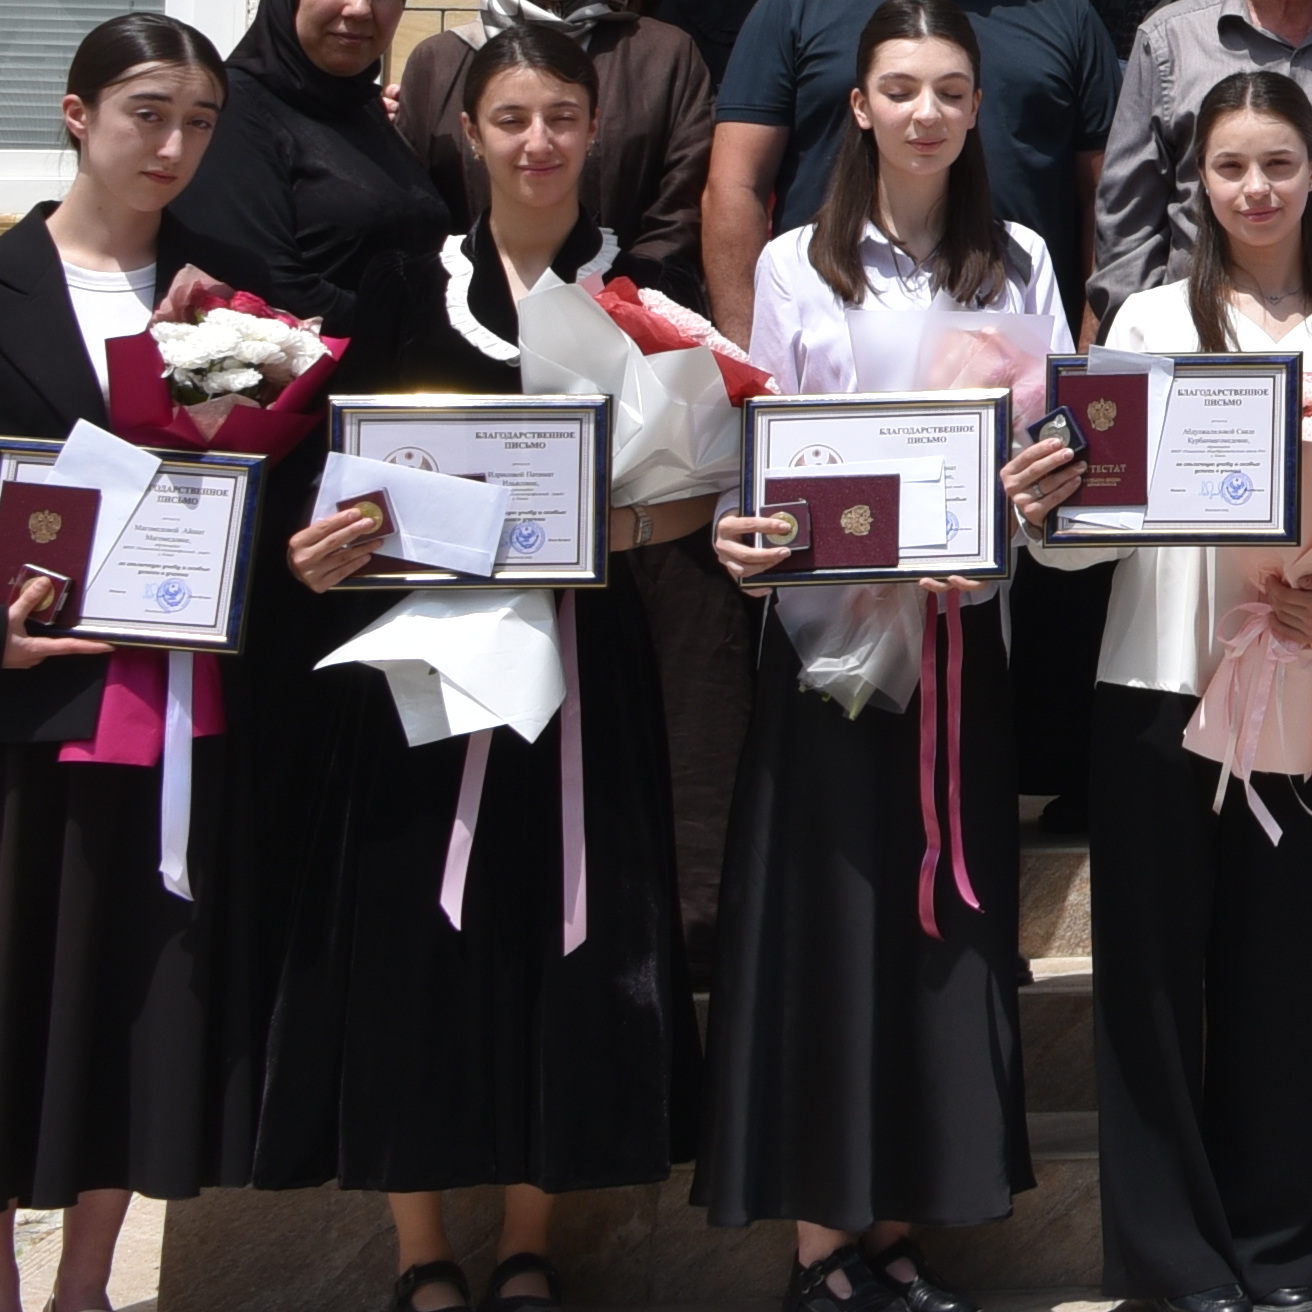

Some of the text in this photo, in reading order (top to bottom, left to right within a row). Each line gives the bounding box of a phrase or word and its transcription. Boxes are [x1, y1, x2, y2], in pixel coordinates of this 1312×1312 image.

[1177, 388, 1269, 397] БЛАГОДАРСТВЕННОЕ
[879, 425, 975, 435] БЛАГОДАРСТВЕННОЕ
[475, 431, 576, 439] БЛАГОДАРСТВЕННОЕ
[907, 436, 947, 444] ПИСЬМО
[504, 441, 546, 449] ПИСЬМО
[1088, 464, 1127, 473] ТЕСТАТ
[157, 495, 199, 505] ПИСЬМО
